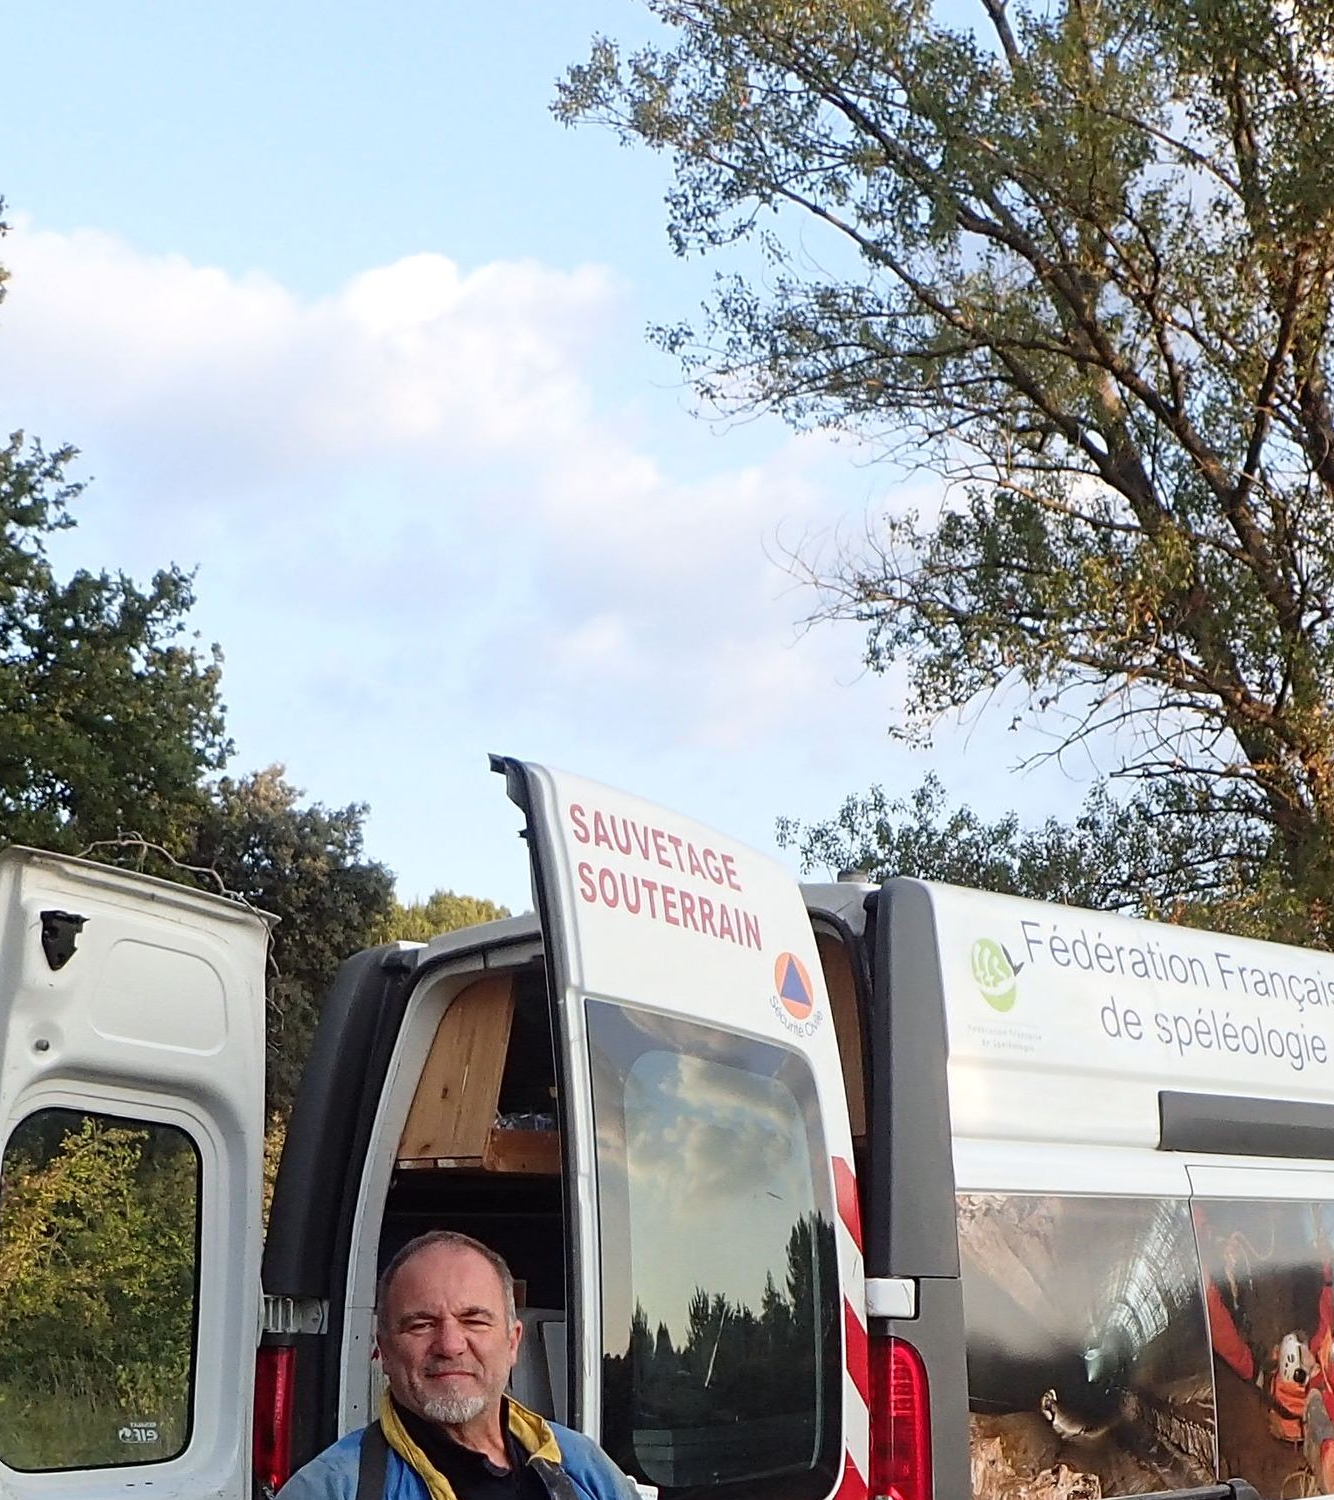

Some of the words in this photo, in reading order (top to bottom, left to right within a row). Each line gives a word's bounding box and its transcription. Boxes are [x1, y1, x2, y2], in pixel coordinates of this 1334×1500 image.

[569, 803, 742, 892] SAUVETAGE
[577, 861, 762, 951] SOUTERRAIN
[1019, 920, 1212, 988] Fédération
[1100, 997, 1144, 1041] de
[1155, 1007, 1328, 1071] spéléologie
